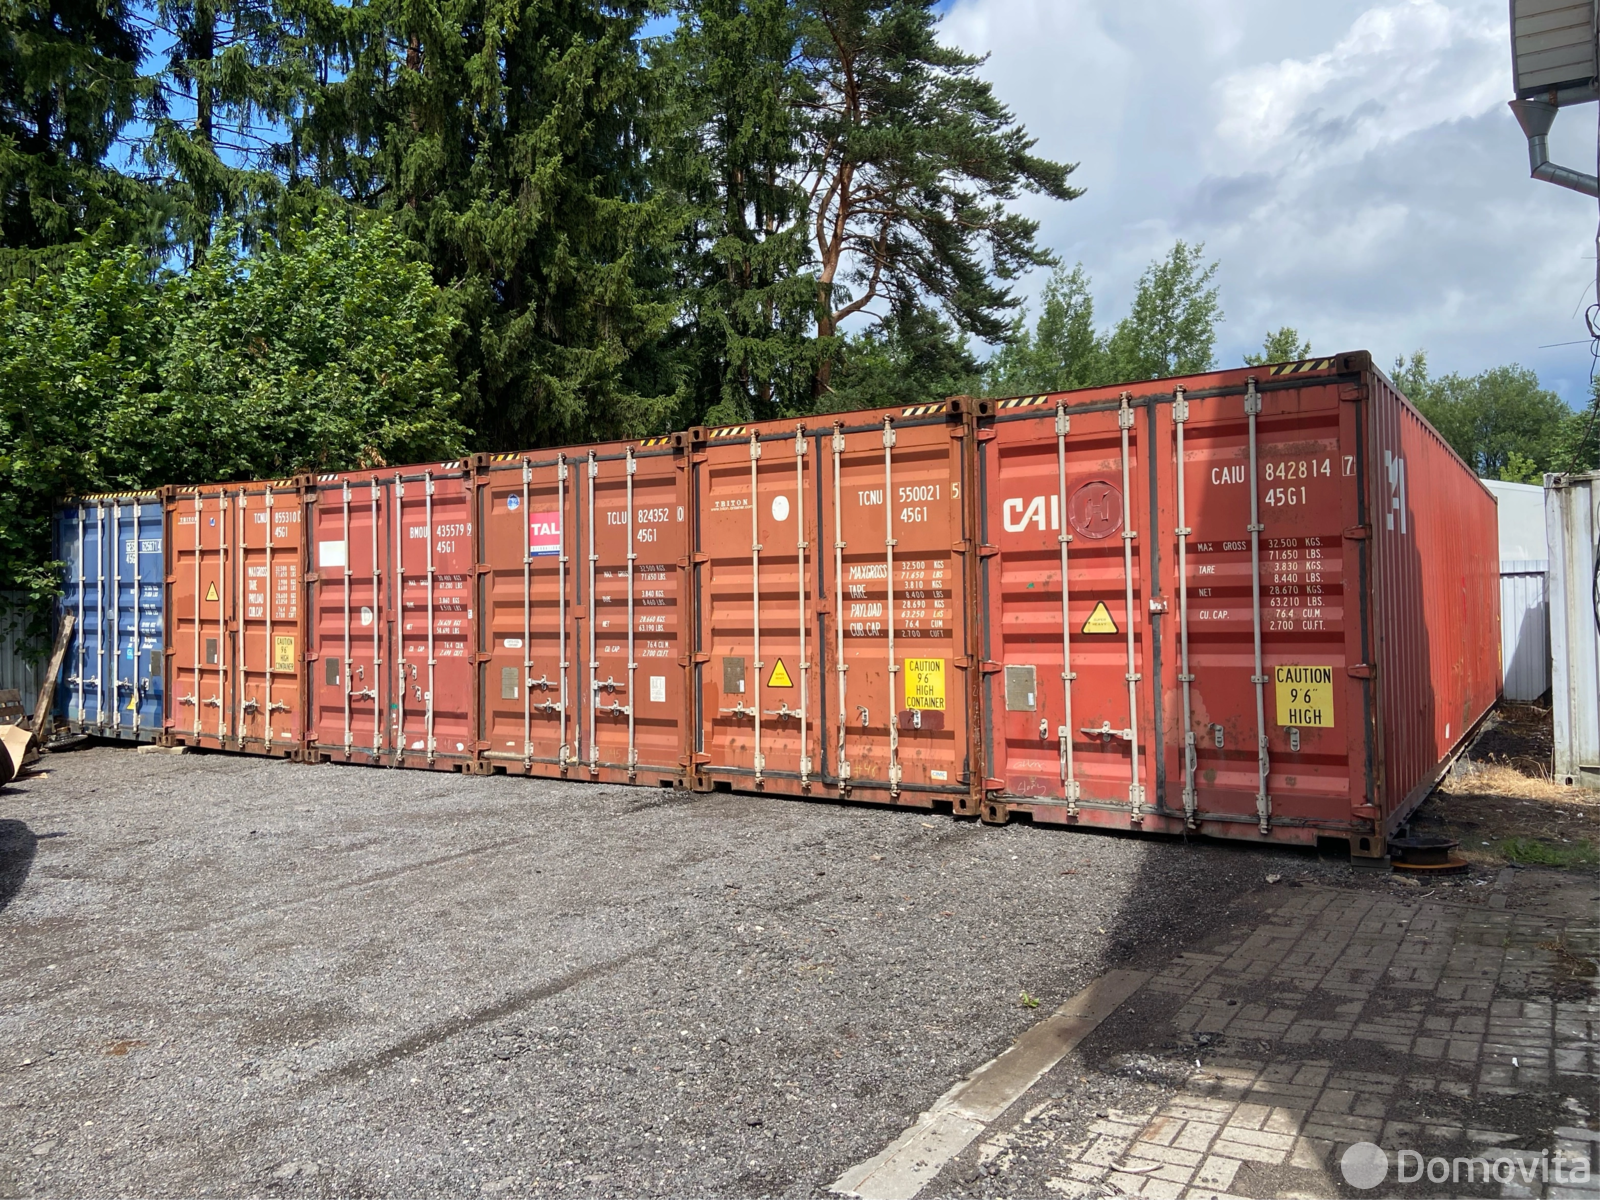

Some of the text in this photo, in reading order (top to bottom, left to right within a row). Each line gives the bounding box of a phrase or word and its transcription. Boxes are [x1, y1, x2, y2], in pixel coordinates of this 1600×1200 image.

[1212, 456, 1354, 485] CAIU 842814 7
[858, 482, 960, 506] TCNU 550021 5
[1265, 486, 1306, 506] 45G1
[715, 499, 748, 508] TRITON
[275, 511, 296, 523] 855310
[607, 506, 684, 525] TCLU 824352 0
[900, 506, 927, 523] 45G1
[1003, 495, 1060, 532] CAI
[275, 527, 288, 538] 45G1
[410, 526, 428, 538] BMOU
[436, 524, 464, 537] 435579
[531, 522, 560, 536] TAL
[637, 528, 657, 542] 45G1
[436, 541, 455, 553] 45G1
[1198, 537, 1323, 552] MAX GROSS 32.500 KGS.
[1269, 549, 1324, 560] 71.650 LBS.
[902, 561, 925, 570] 32.500
[933, 560, 944, 569] KGS
[1199, 561, 1323, 574] TARE 3.830 KGS.
[901, 571, 943, 579] 71.650 LBS
[1274, 573, 1323, 583] 8.440 LBS.
[849, 580, 942, 599] TARE 3.810 KGS
[905, 590, 944, 599] 8.400 LBS
[1199, 585, 1324, 597] NET 28.670 KGS.
[1270, 596, 1325, 607] 63.210 LBS.
[850, 600, 945, 618] PAYLOAD 28.690 KGS
[901, 610, 944, 618] 63.250 LBS
[1275, 609, 1294, 618] 76.4
[905, 620, 919, 628] 76.4
[1270, 621, 1294, 630] 2.700
[902, 630, 921, 638] 2.700
[276, 662, 293, 670] CONTAINER
[909, 660, 941, 672] CAUTION
[1277, 668, 1331, 683] CAUTION
[916, 685, 934, 696] HIGH
[906, 696, 944, 708] CONTAINER
[1289, 709, 1322, 724] HIGH
